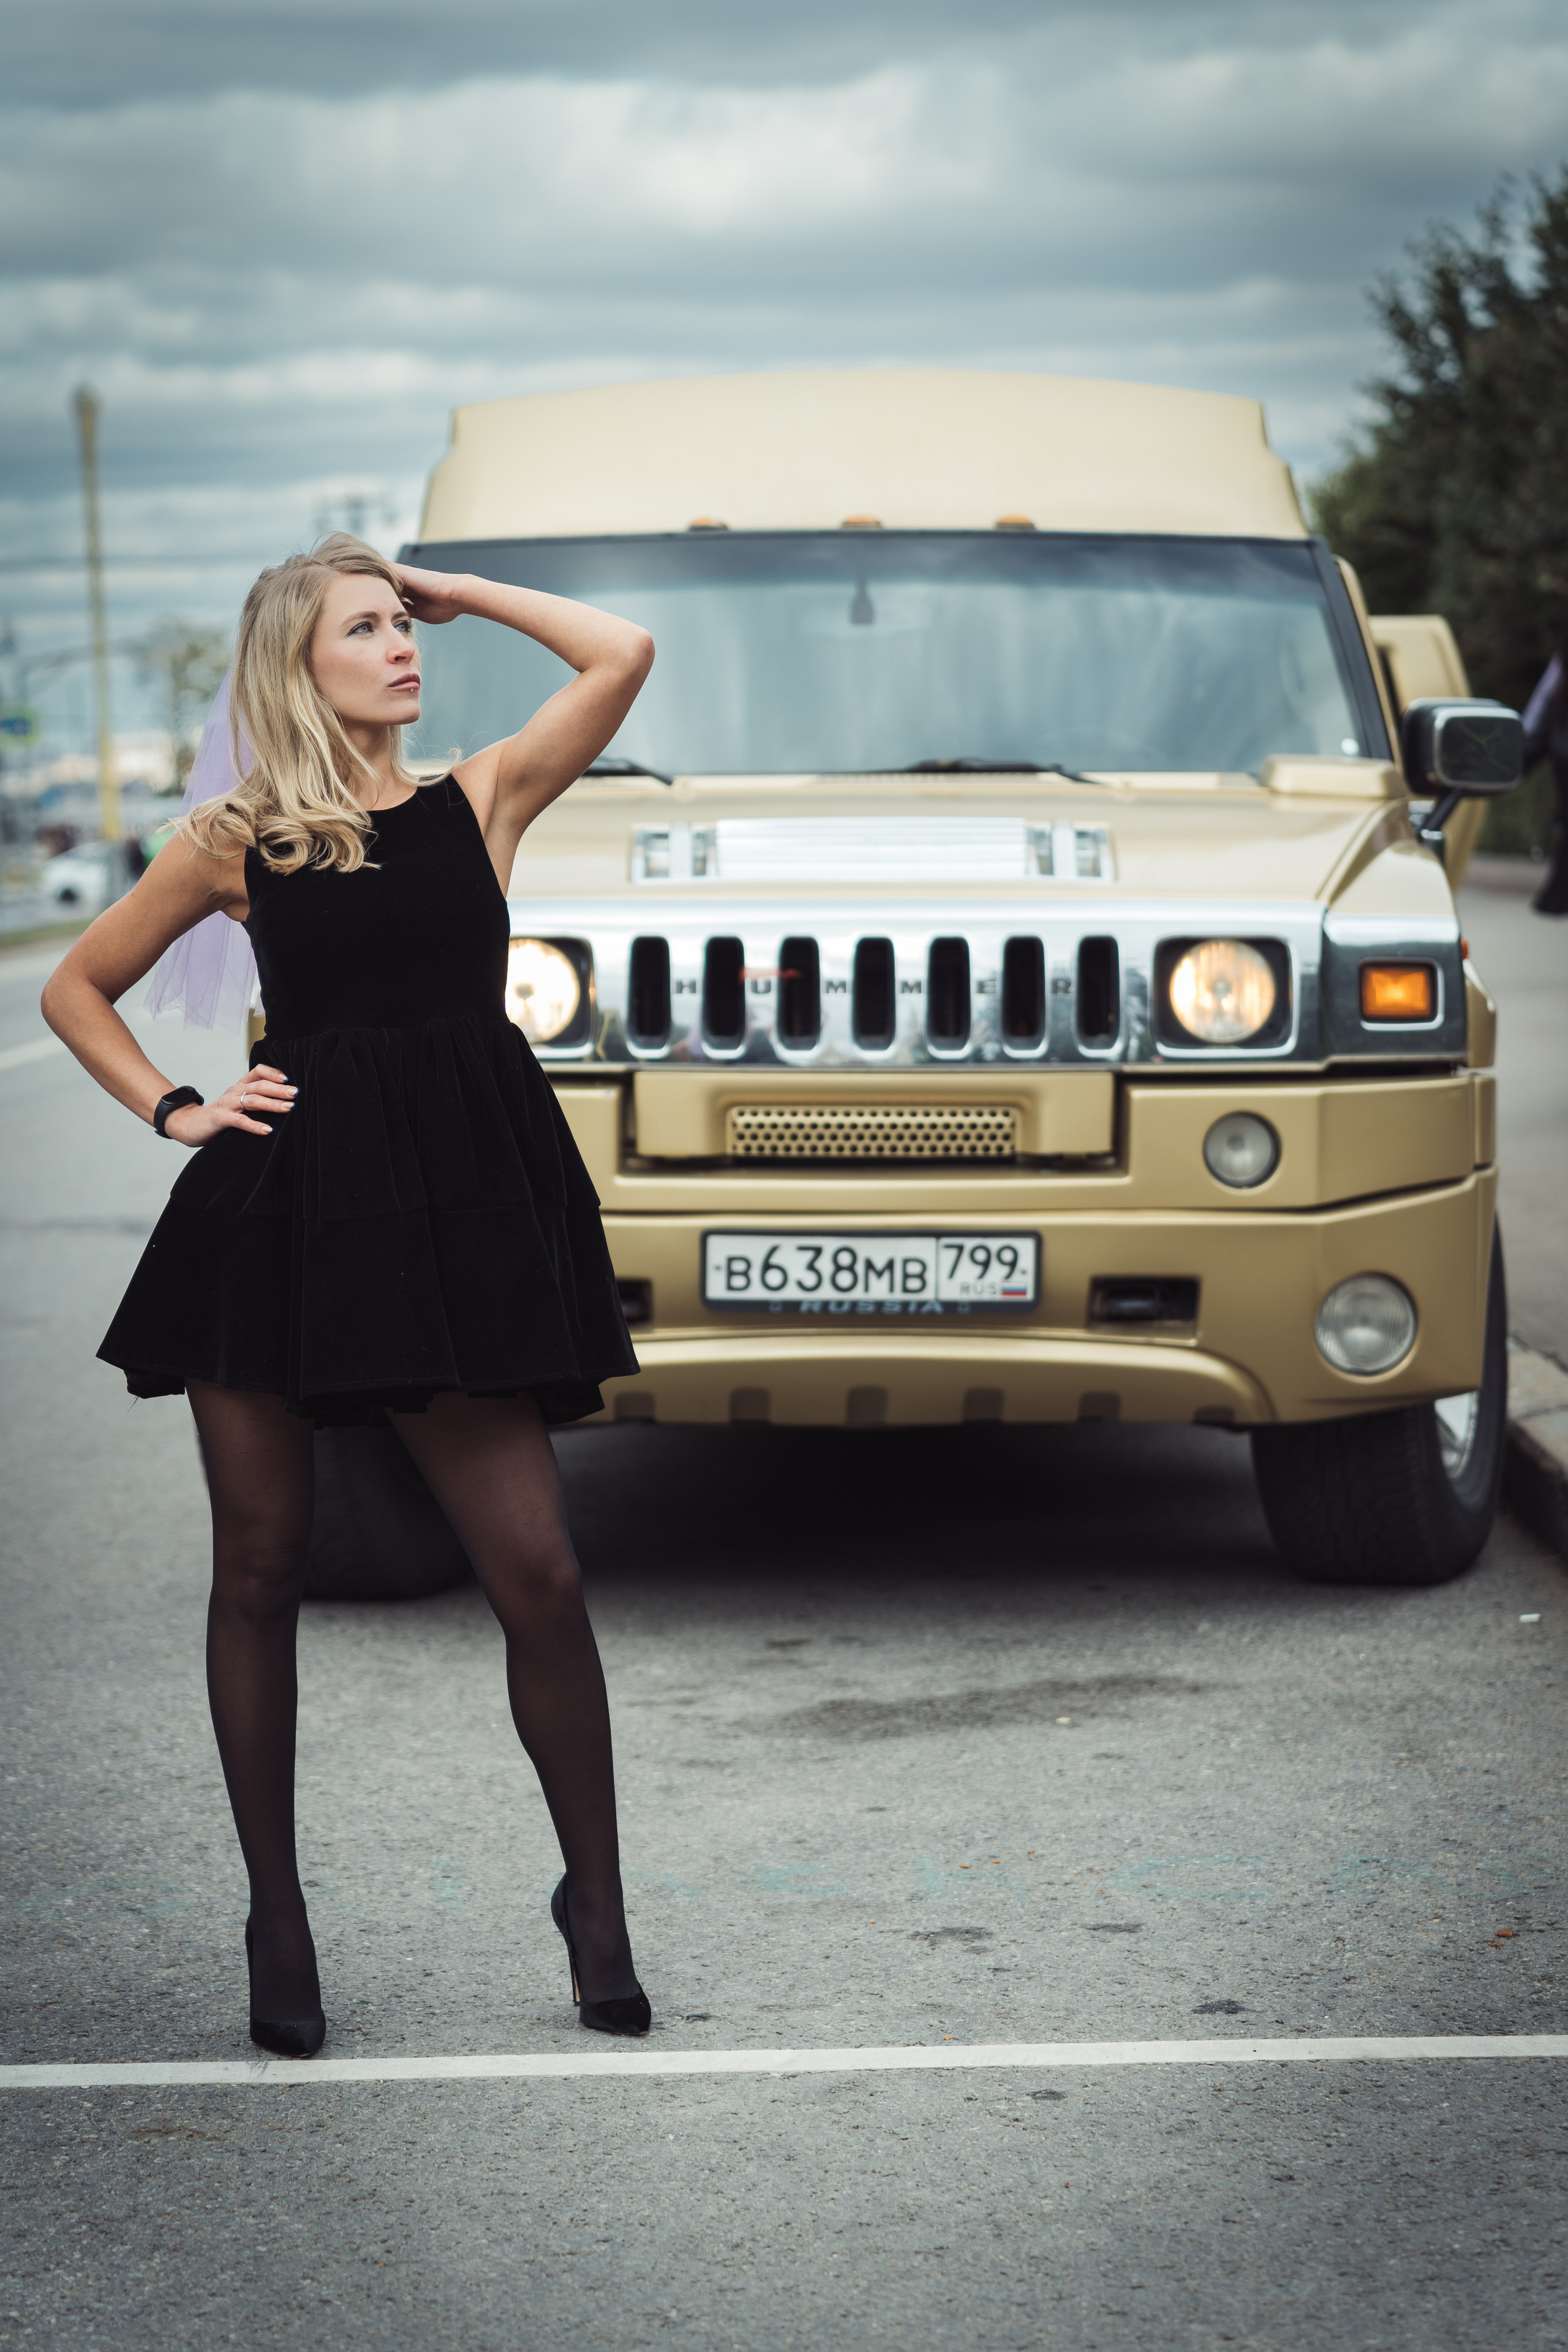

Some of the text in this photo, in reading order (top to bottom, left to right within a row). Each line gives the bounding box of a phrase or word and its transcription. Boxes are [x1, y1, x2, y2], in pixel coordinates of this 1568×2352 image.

[674, 978, 1072, 995] HUMMER
[942, 1244, 1019, 1280] 799
[959, 1282, 997, 1295] RUS
[799, 1300, 944, 1314] RUSSIA
